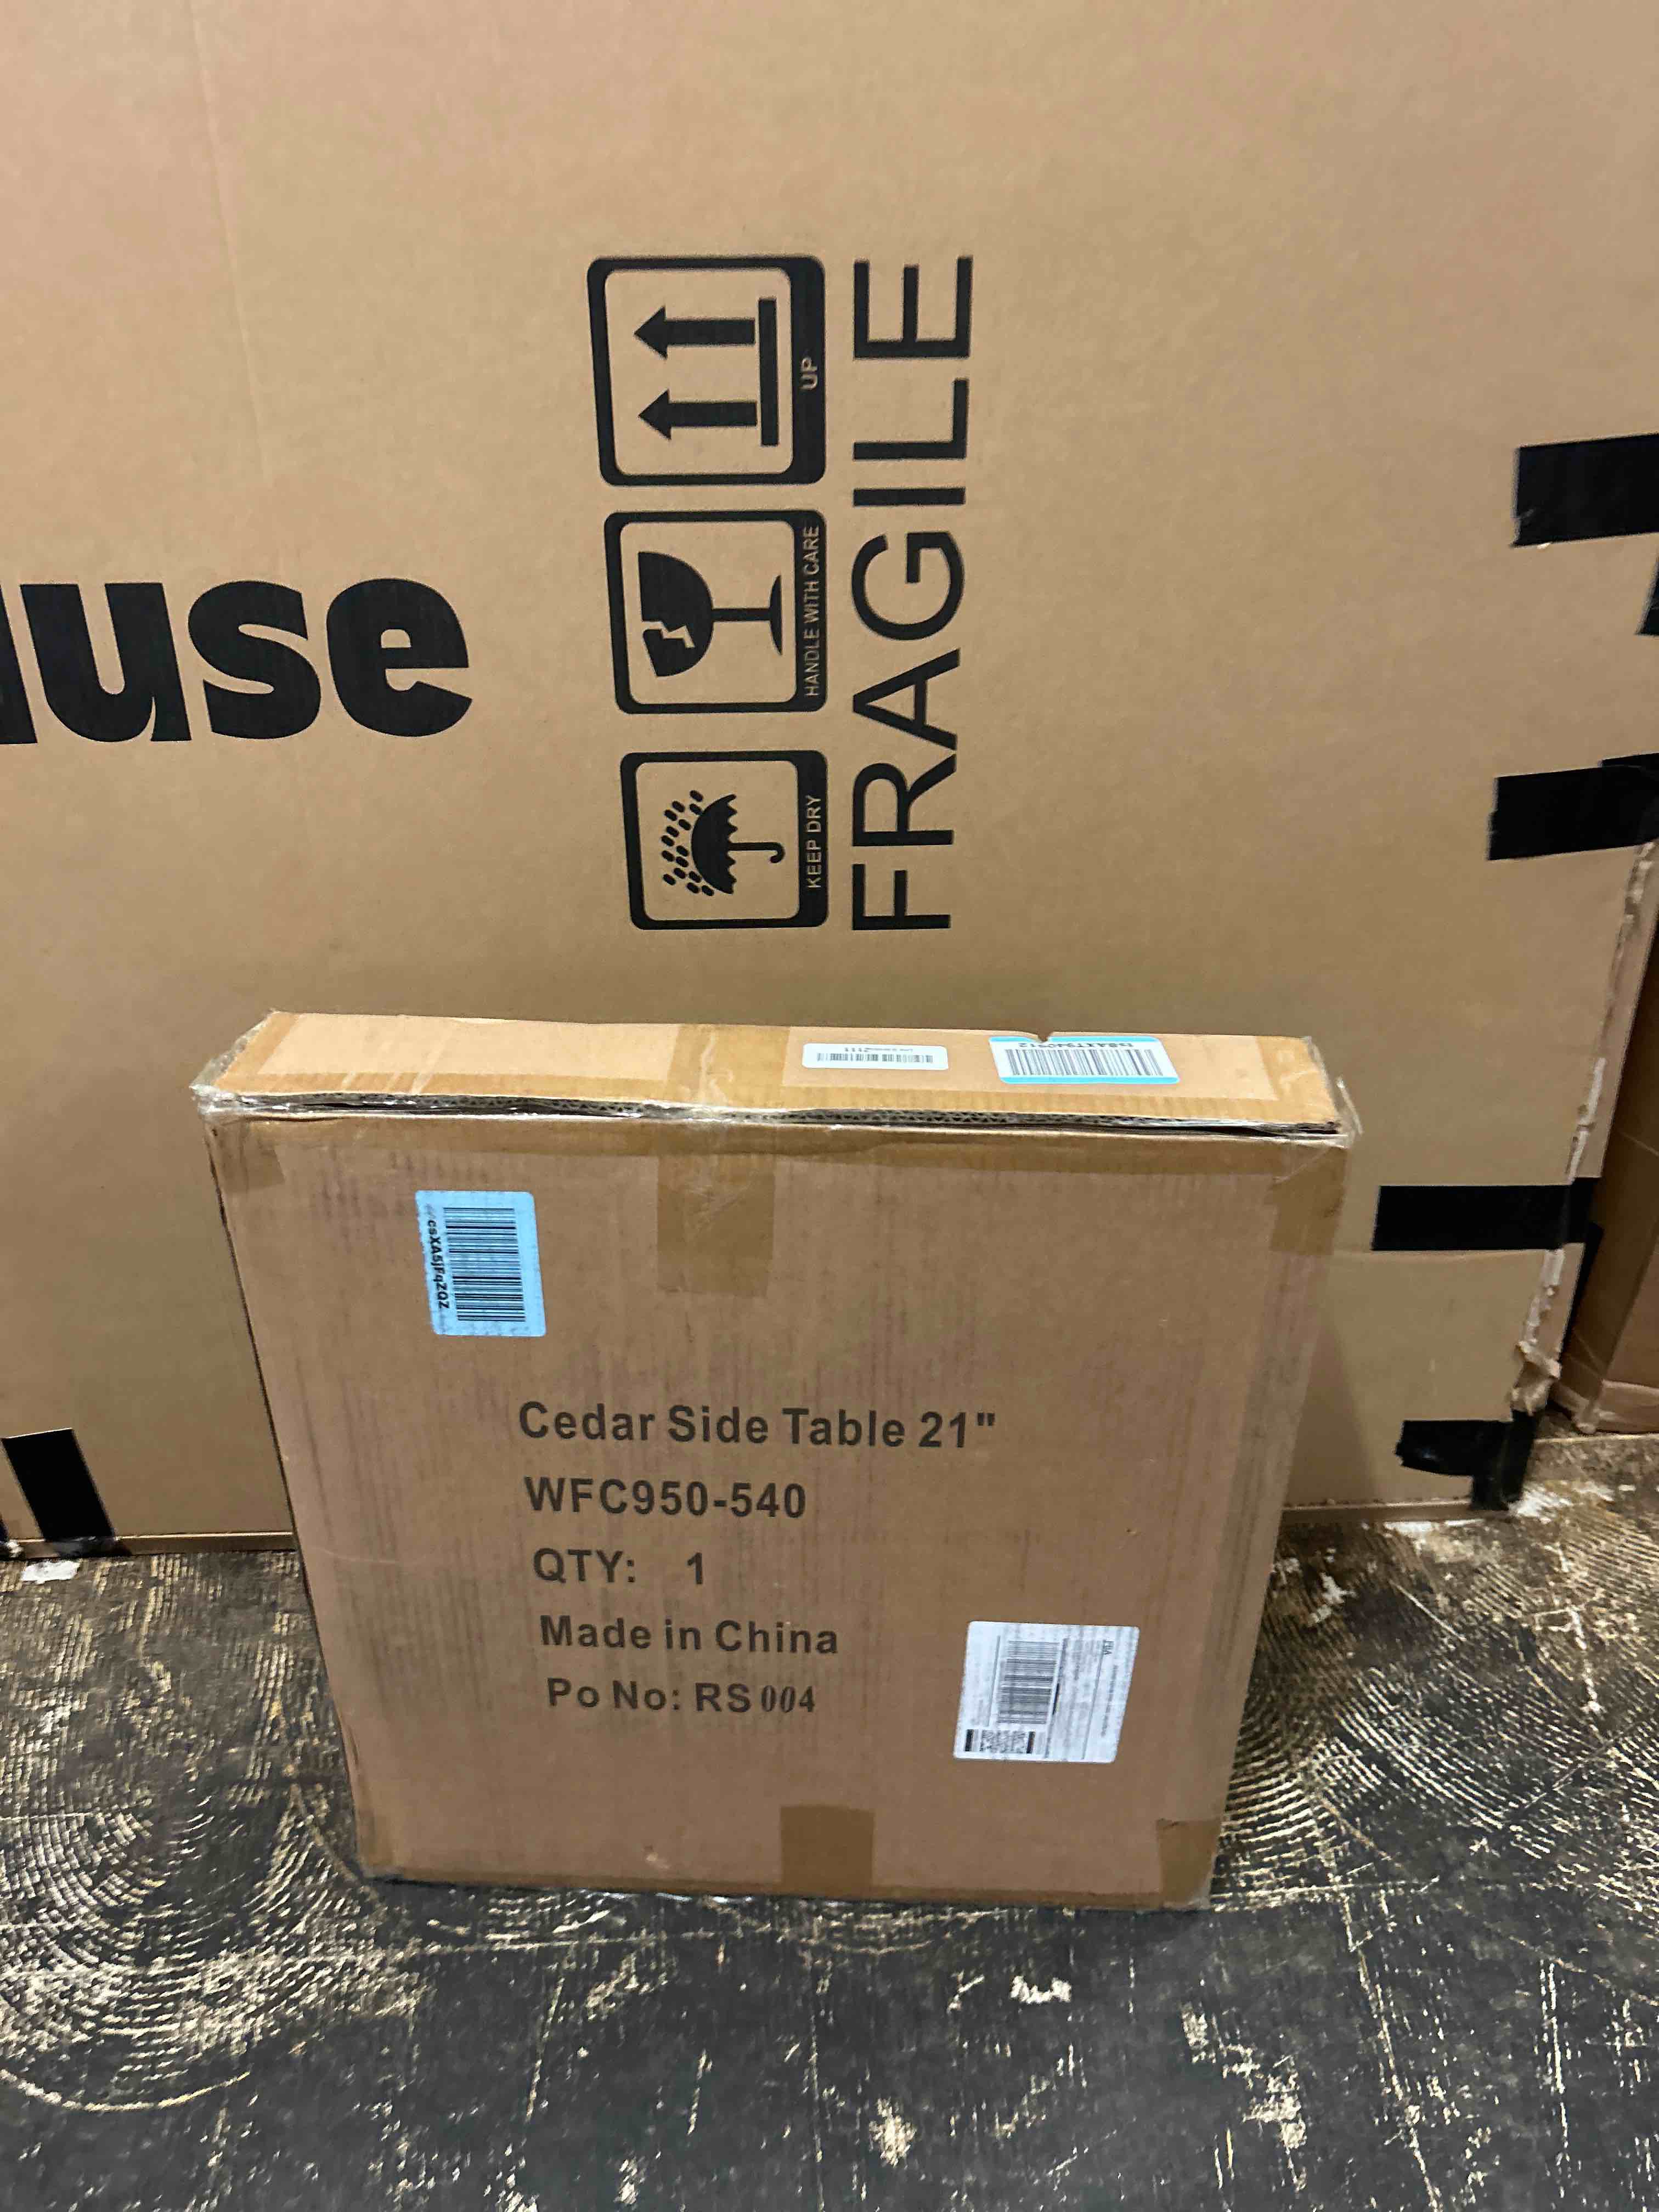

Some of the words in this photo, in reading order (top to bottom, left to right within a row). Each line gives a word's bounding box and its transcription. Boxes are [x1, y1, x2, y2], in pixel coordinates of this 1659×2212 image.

[799, 356, 819, 391] UP
[802, 525, 820, 576] CARE
[803, 579, 821, 623] WITH
[851, 255, 973, 931] FRAGILE
[0, 577, 473, 744] use
[803, 627, 821, 698] HANDLE
[806, 794, 822, 832] DRY
[806, 839, 822, 889] KEEP
[519, 1401, 655, 1441] Cedar
[668, 1404, 769, 1443] Side
[782, 1407, 905, 1447] Table
[919, 1412, 996, 1448] 21"
[525, 1476, 806, 1519] WFC950-540
[533, 1548, 635, 1583] QTY:
[687, 1553, 704, 1585] 1
[540, 1615, 651, 1649] Made
[664, 1619, 701, 1650] in
[715, 1620, 838, 1654] China
[548, 1678, 600, 1708] Po
[613, 1680, 680, 1711] No:
[696, 1683, 751, 1713] RS
[761, 1685, 815, 1713] 004
